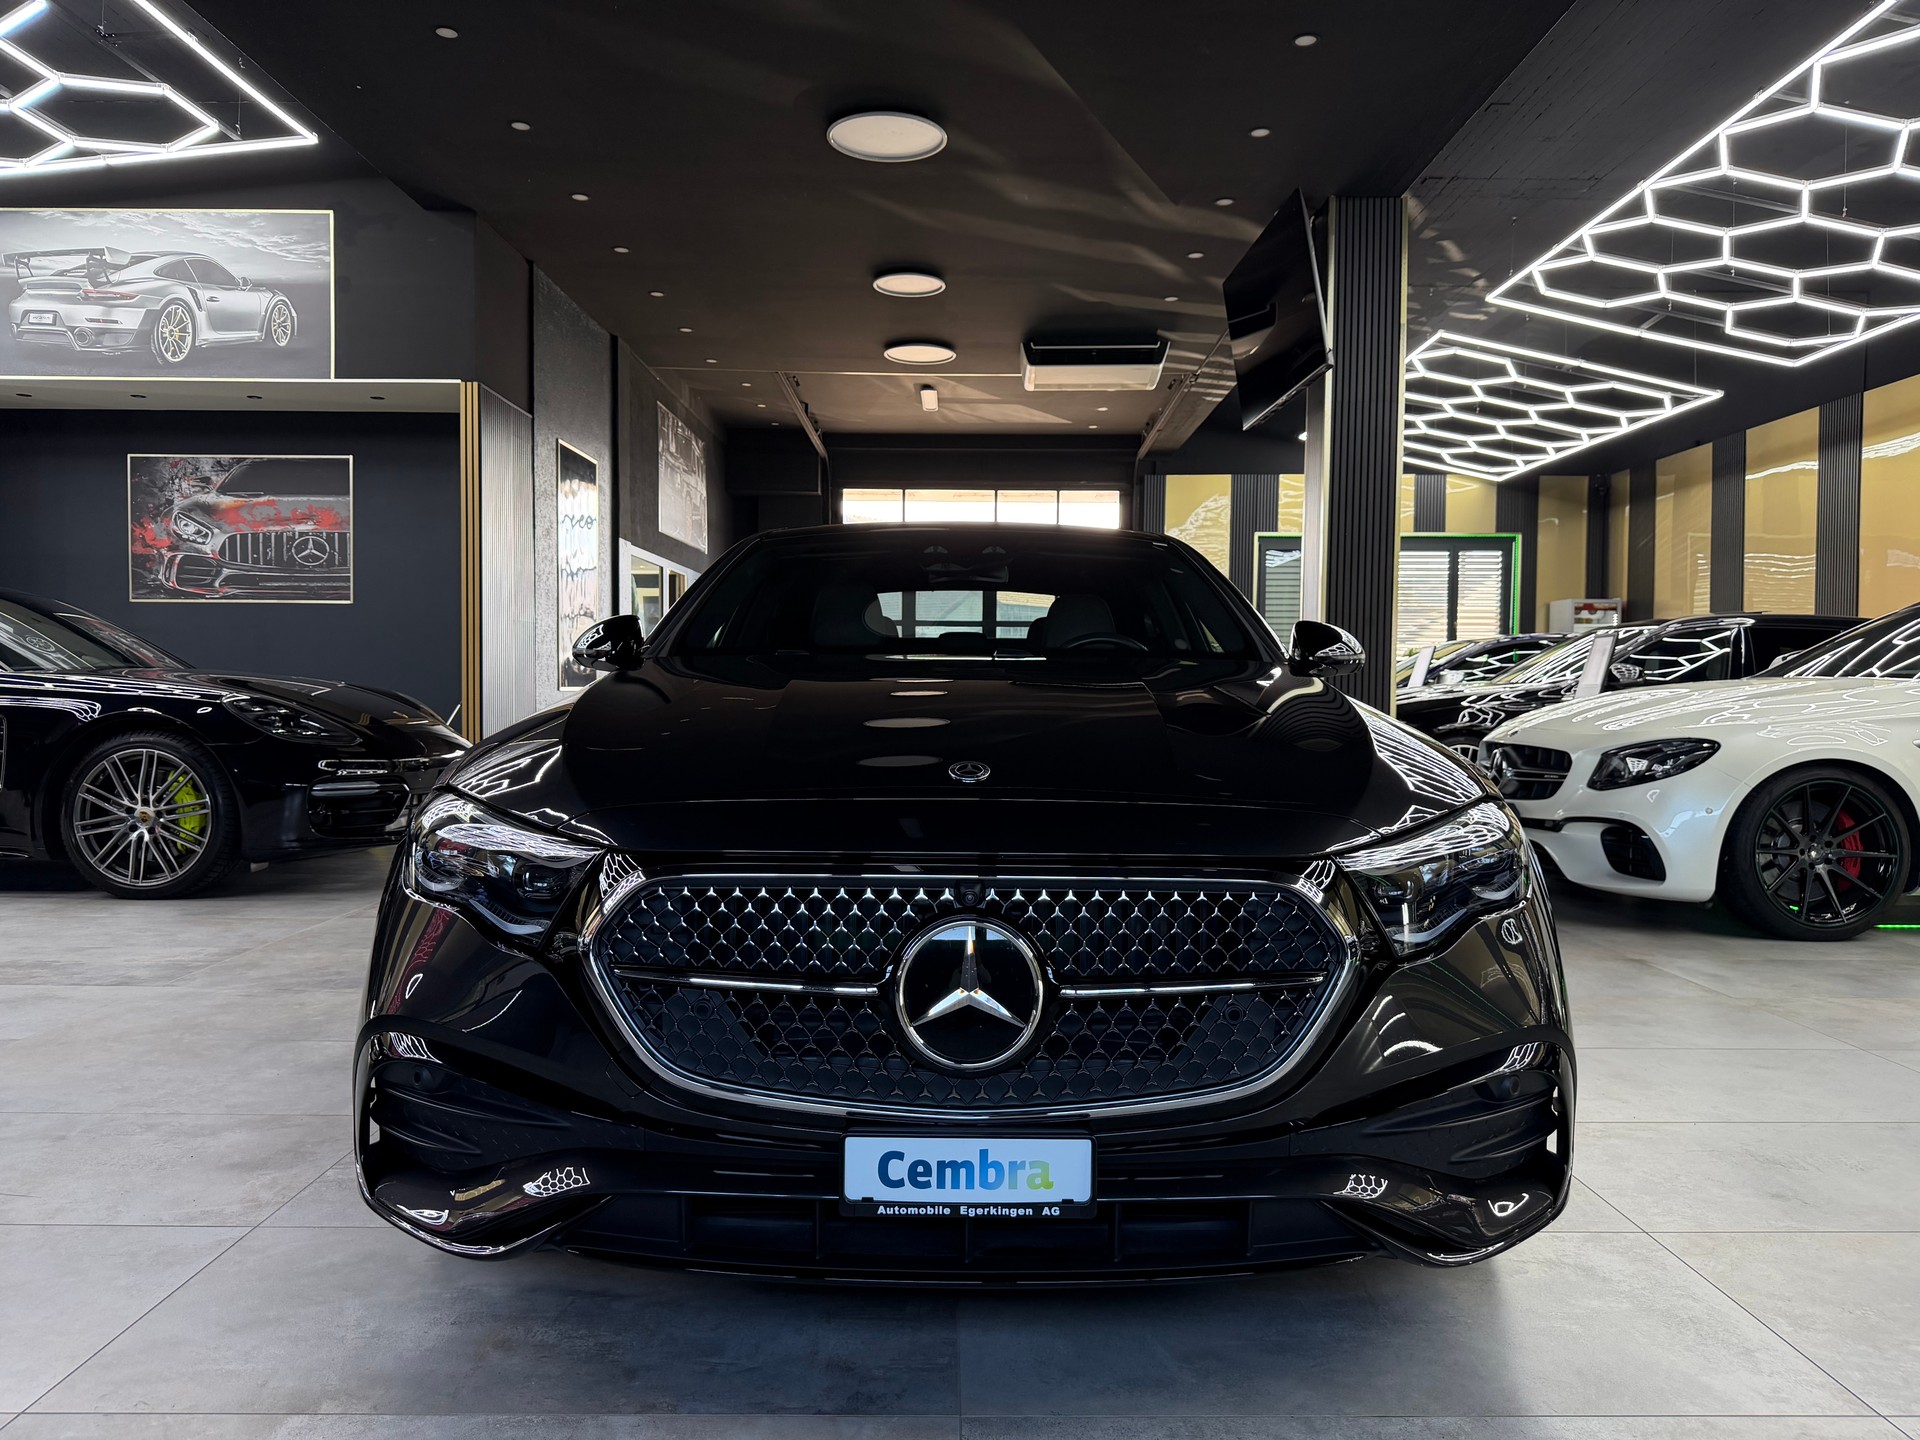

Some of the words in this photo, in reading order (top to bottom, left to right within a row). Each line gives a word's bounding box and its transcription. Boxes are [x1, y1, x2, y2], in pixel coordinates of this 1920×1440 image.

[877, 1148, 1054, 1191] Cembra
[877, 1205, 951, 1216] Automobile
[959, 1206, 1033, 1217] Egerkingen
[1041, 1206, 1060, 1216] AG
